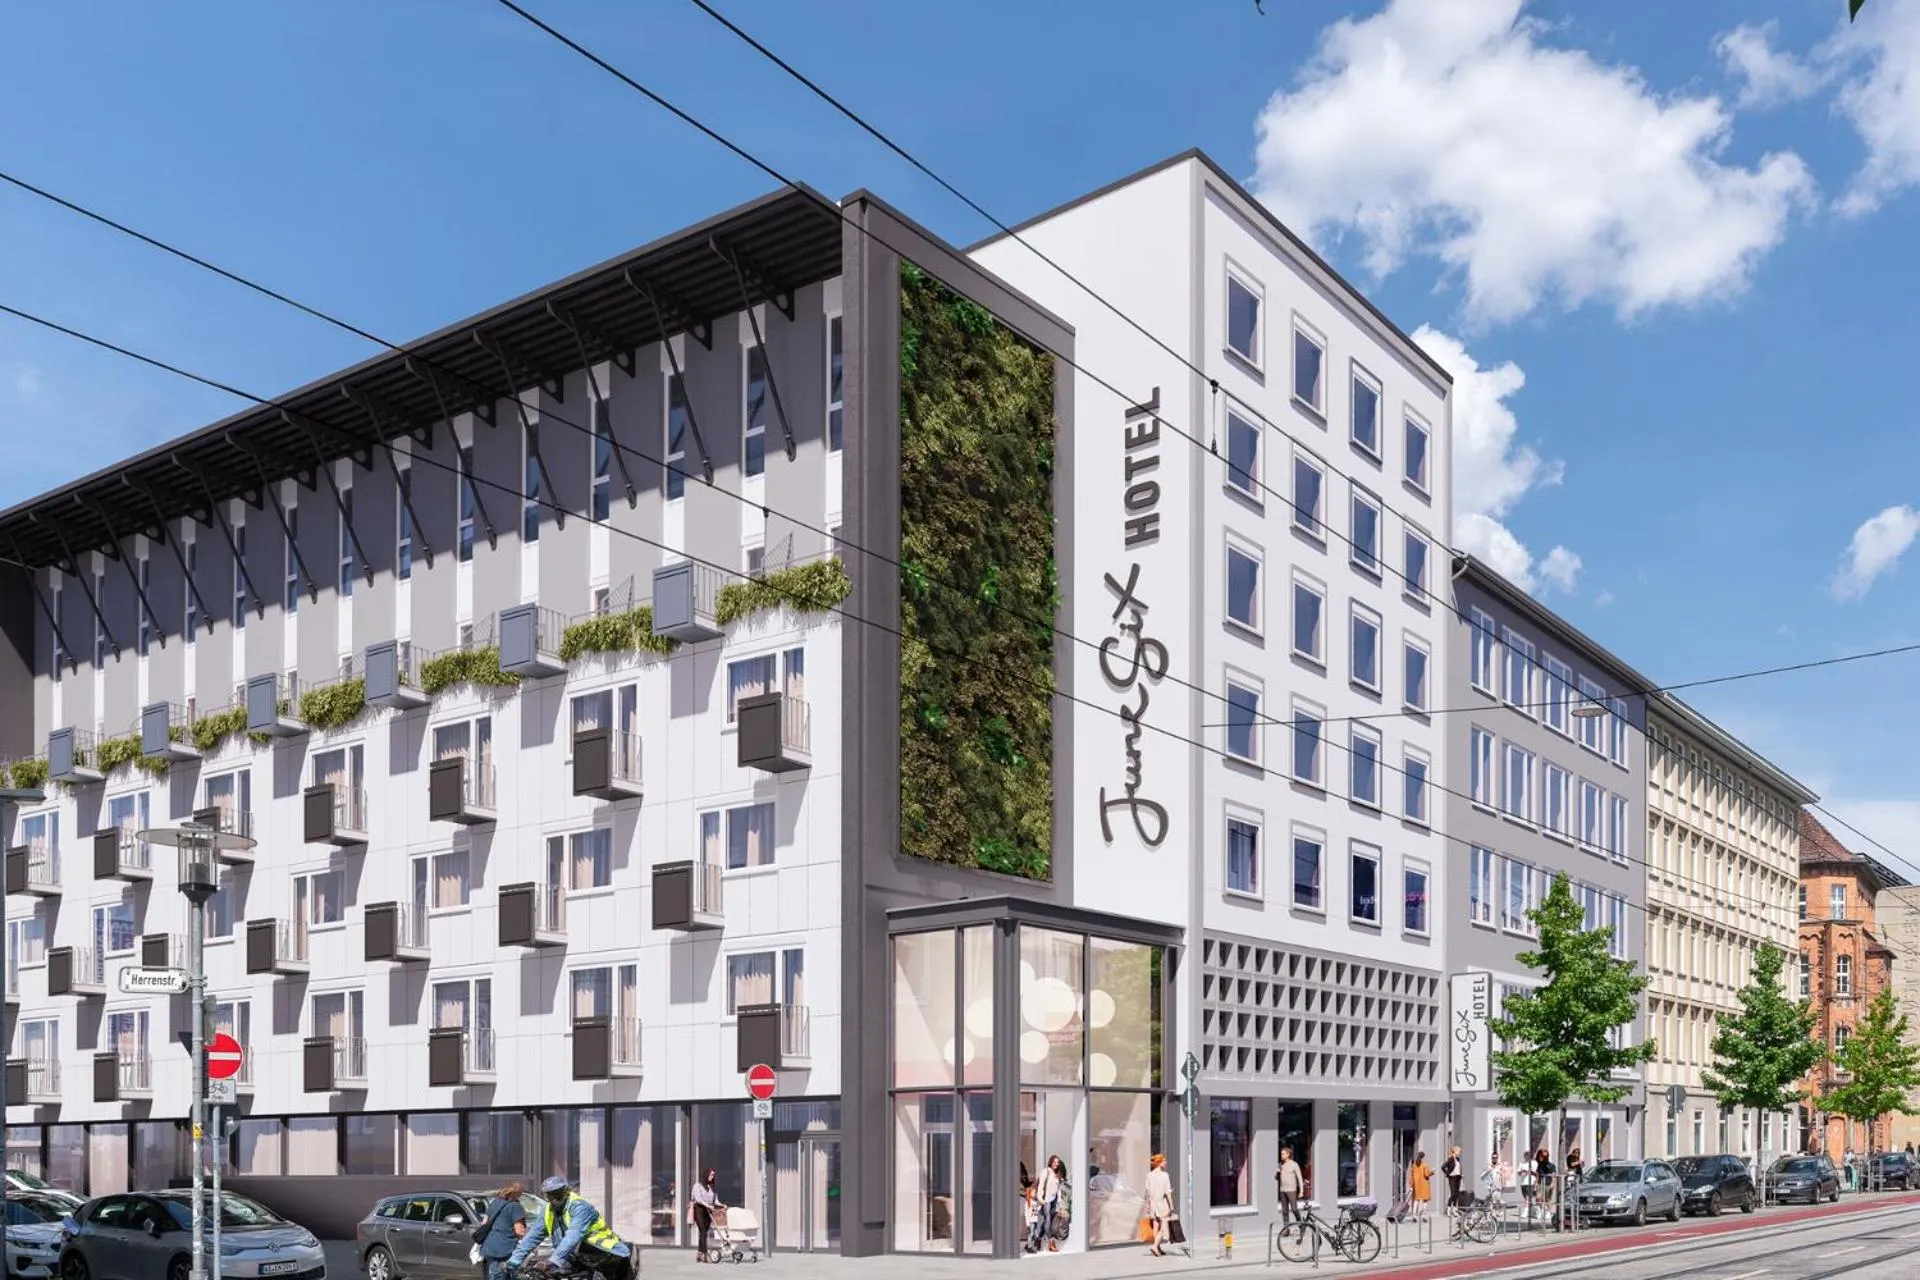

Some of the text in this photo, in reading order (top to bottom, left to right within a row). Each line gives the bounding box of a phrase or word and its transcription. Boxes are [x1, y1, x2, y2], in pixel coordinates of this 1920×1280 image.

[1124, 386, 1160, 549] HOTEL
[131, 973, 177, 986] Herrenstr.
[1473, 977, 1485, 1019] HOTEL
